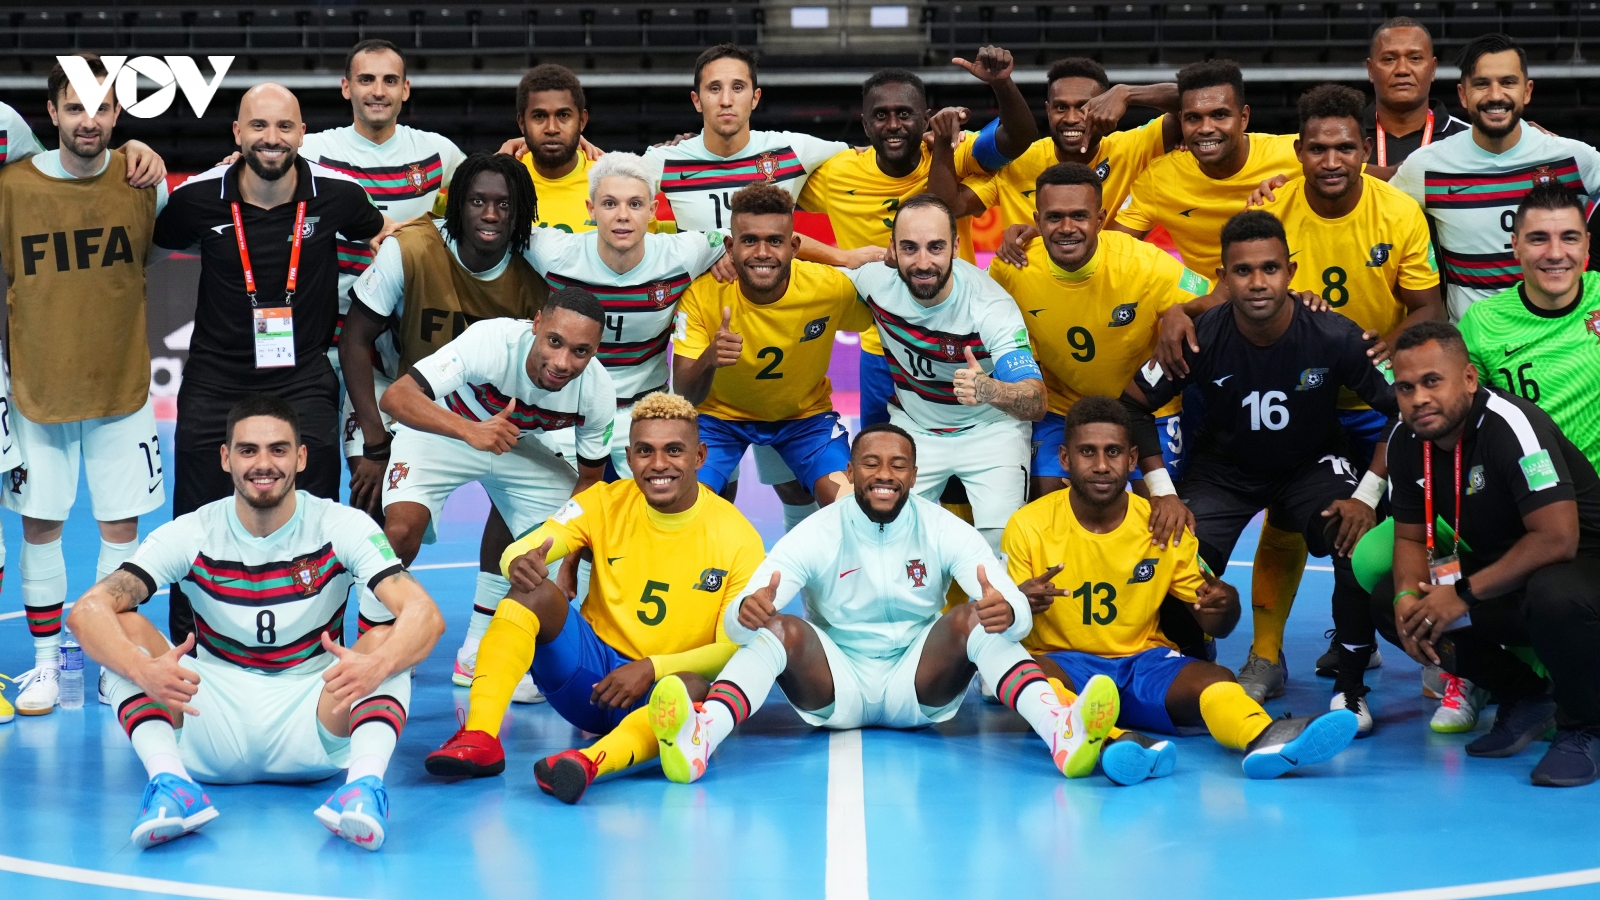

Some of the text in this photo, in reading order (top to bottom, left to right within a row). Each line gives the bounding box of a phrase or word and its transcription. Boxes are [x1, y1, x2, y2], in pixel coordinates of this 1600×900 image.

[21, 226, 134, 276] FIFA
[245, 270, 253, 283] FIFA
[289, 267, 297, 280] FIFA
[1322, 266, 1350, 309] 8
[755, 346, 784, 380] 2
[1066, 326, 1096, 363] 9
[904, 348, 936, 379] 10
[1498, 362, 1541, 404] 16
[1242, 390, 1290, 431] 16
[1166, 416, 1183, 454] 9
[637, 580, 670, 626] 5
[1073, 582, 1118, 626] 13
[256, 610, 277, 645] 8
[659, 695, 668, 729] FUT
[1095, 701, 1105, 729] FUT
